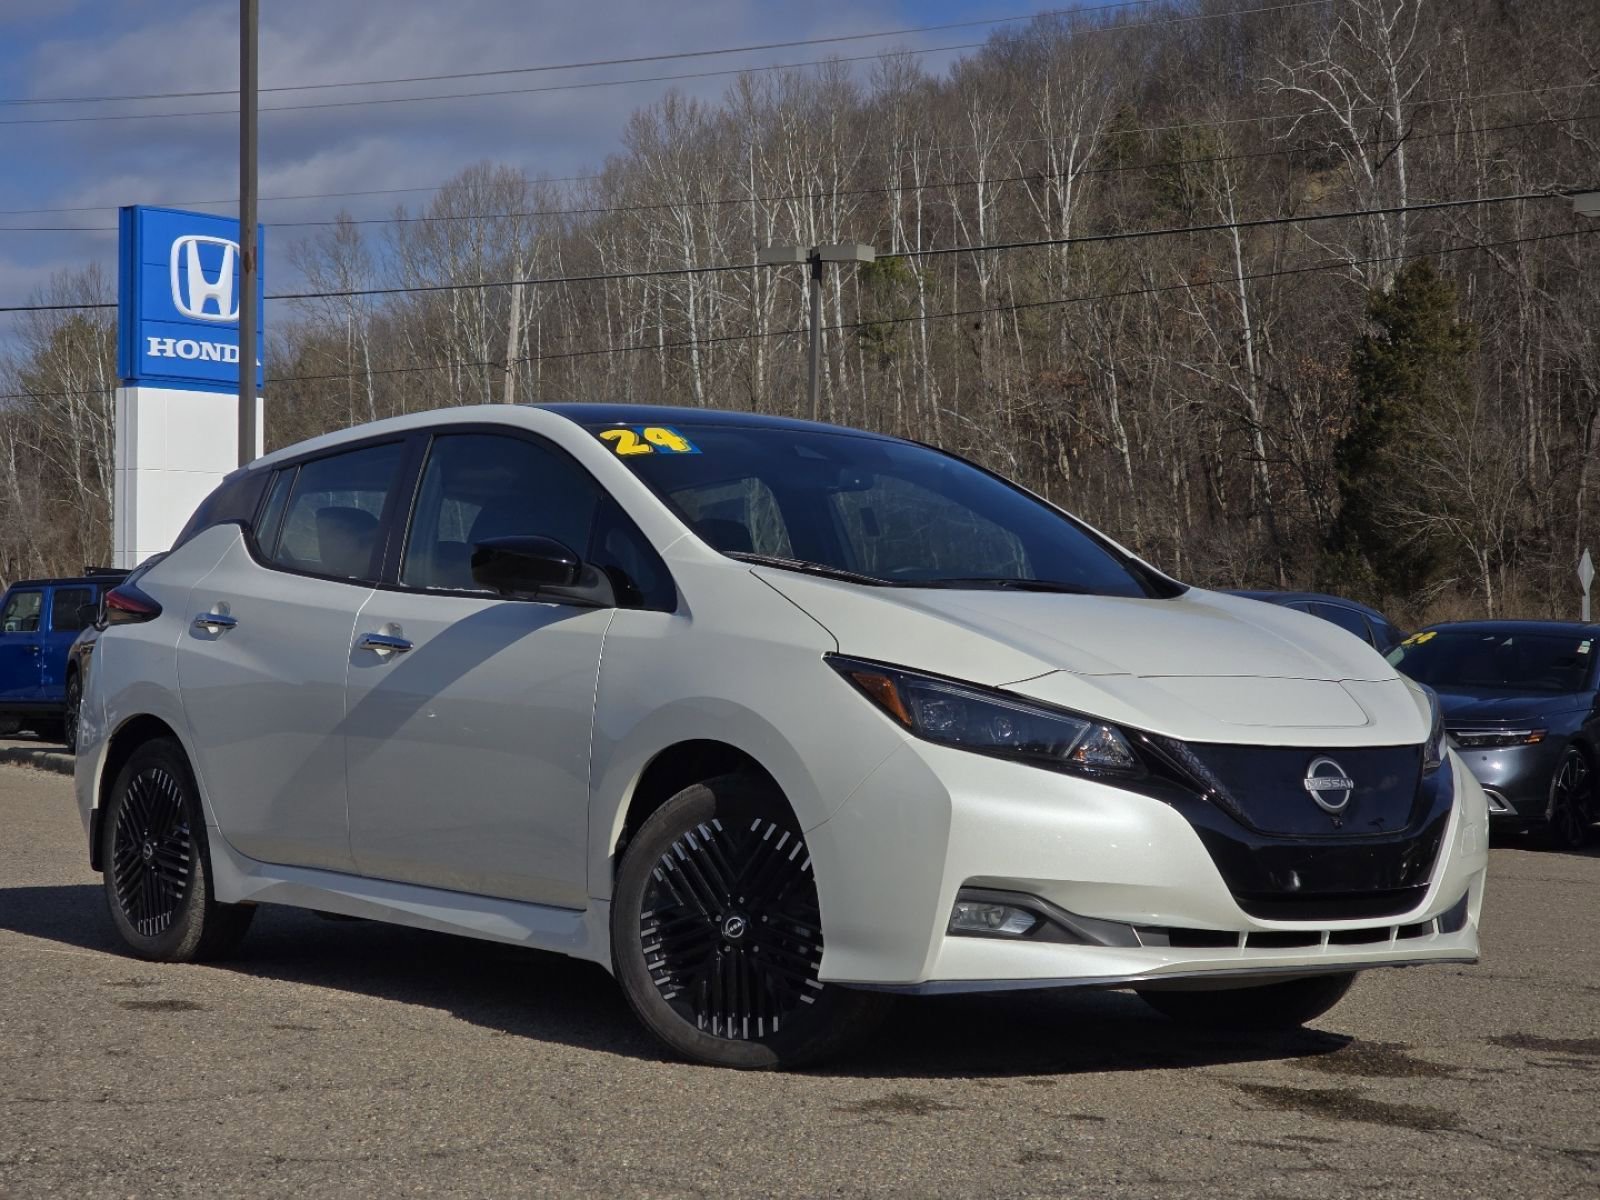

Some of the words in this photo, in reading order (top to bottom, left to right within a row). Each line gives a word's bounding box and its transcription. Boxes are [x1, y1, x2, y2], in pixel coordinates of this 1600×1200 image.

[147, 336, 261, 367] HOND
[599, 427, 692, 455] 24
[1304, 777, 1354, 790] NISSAN
